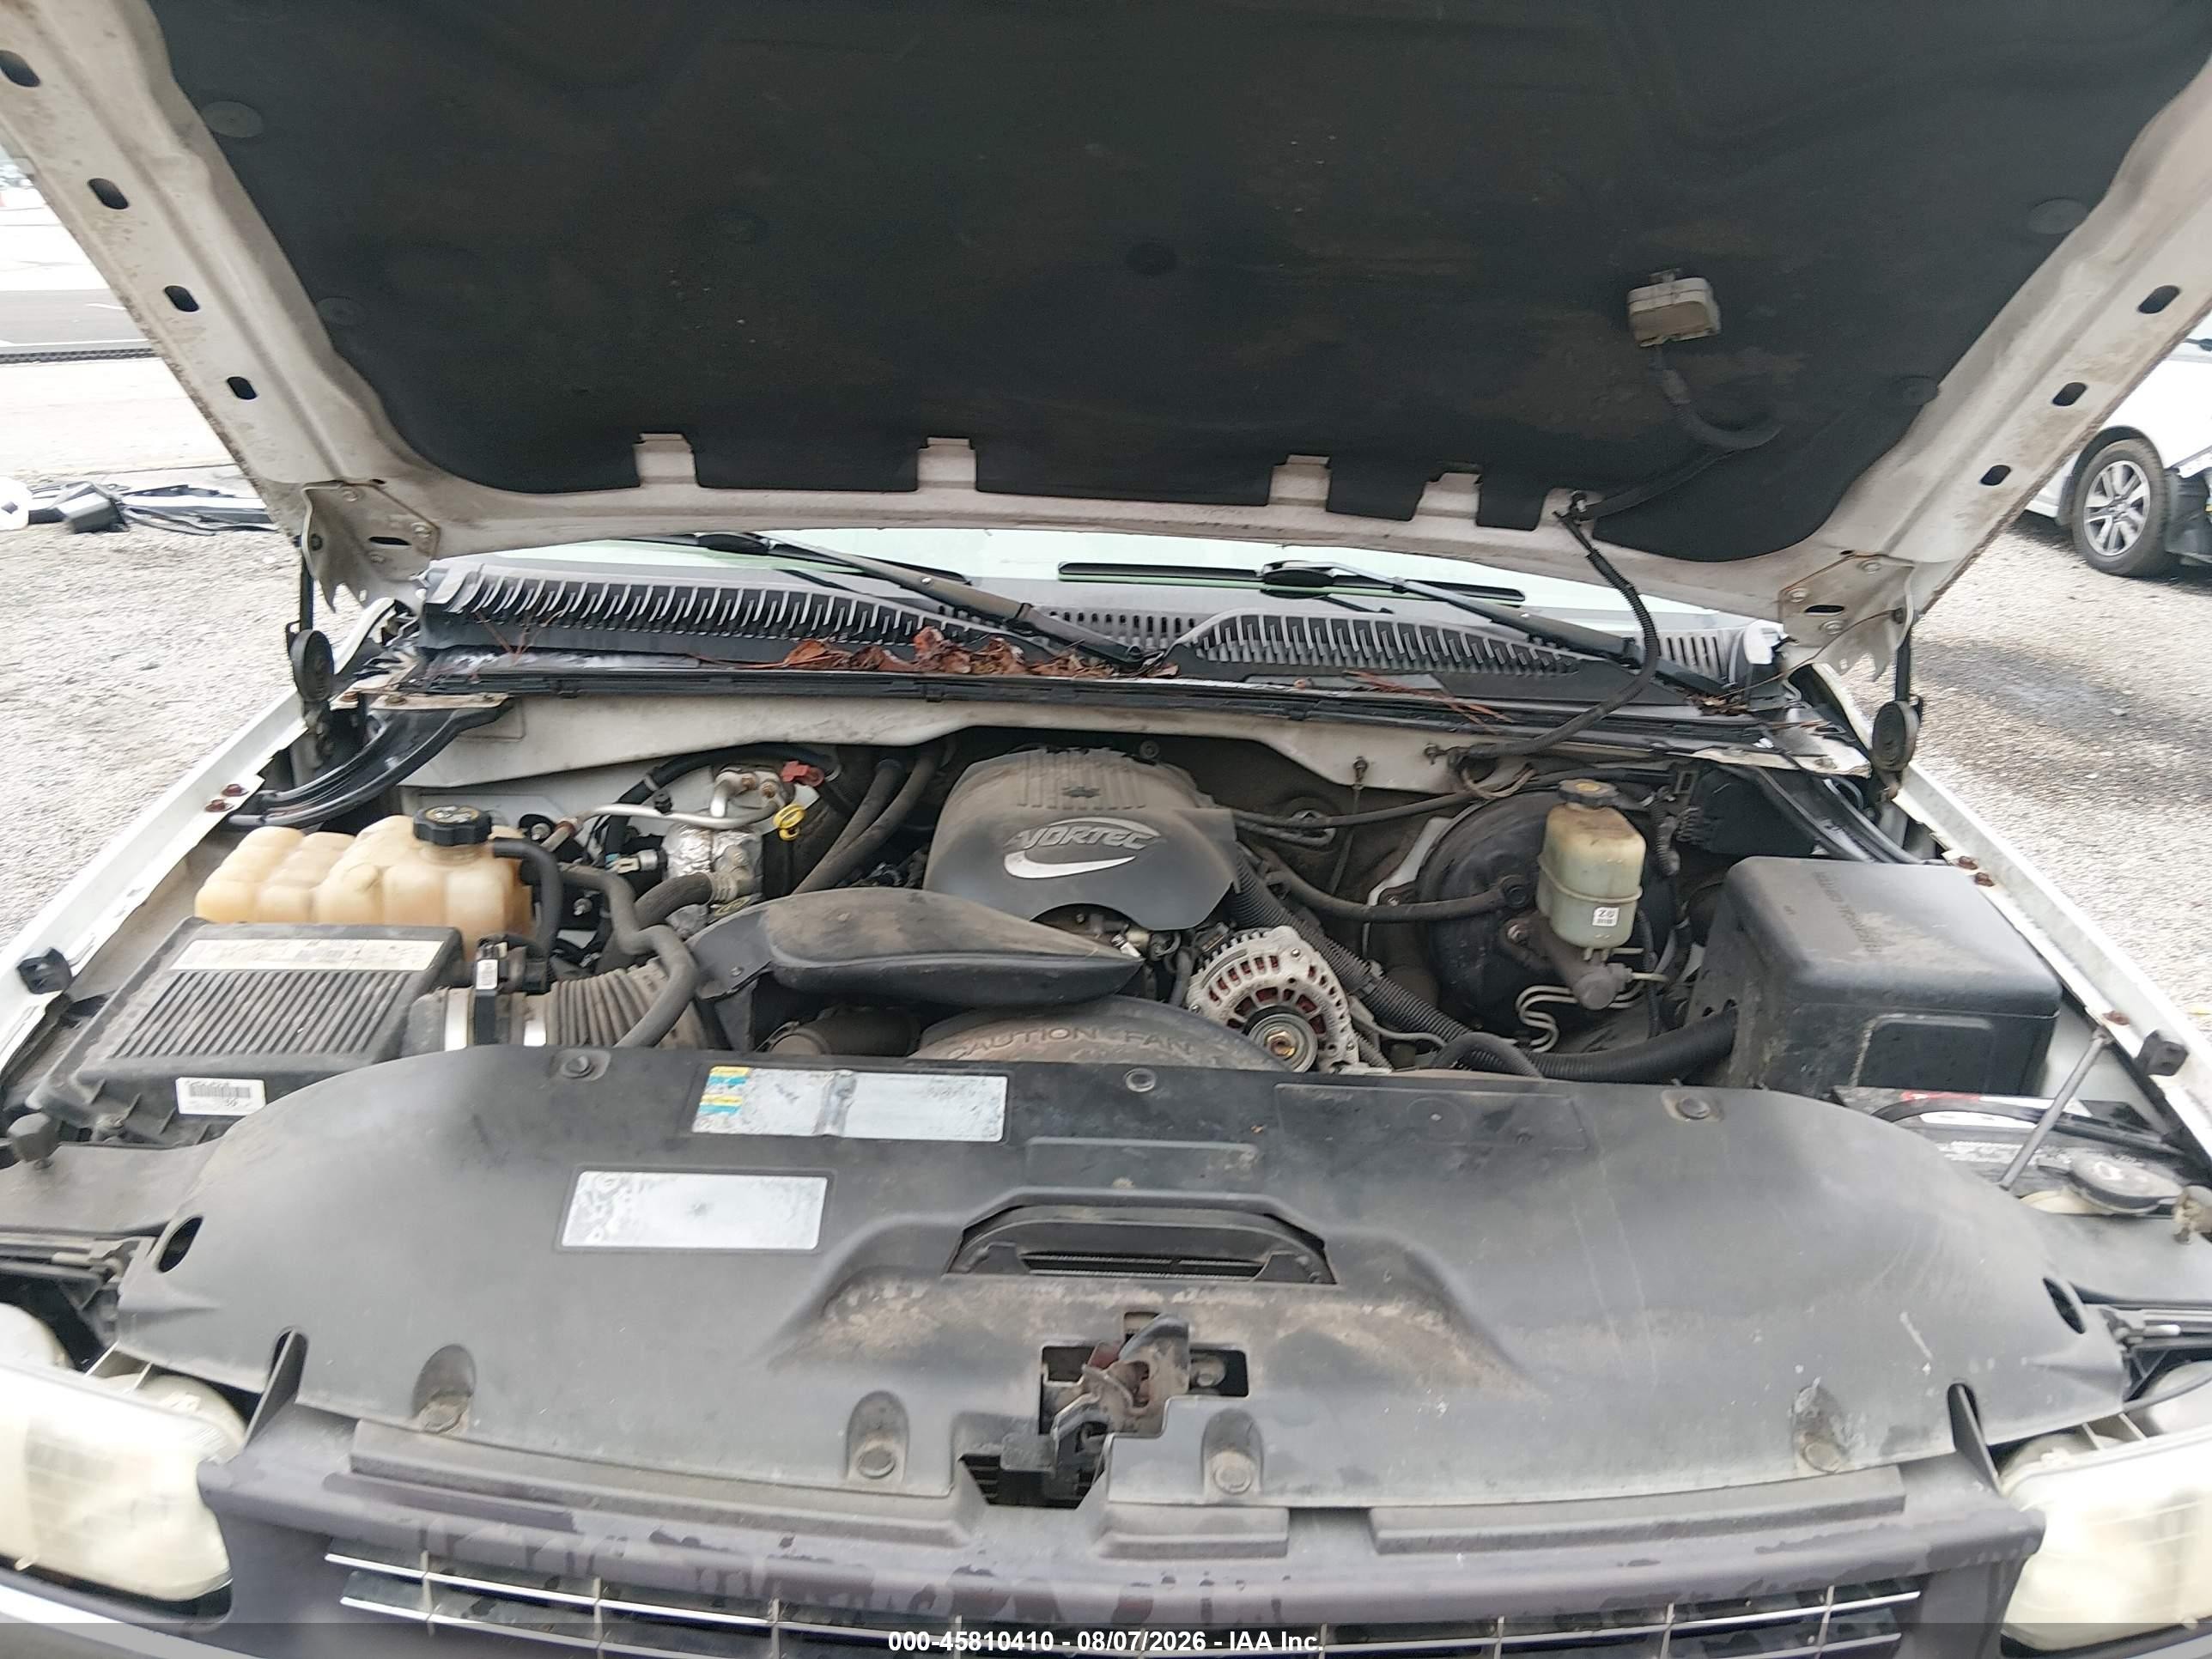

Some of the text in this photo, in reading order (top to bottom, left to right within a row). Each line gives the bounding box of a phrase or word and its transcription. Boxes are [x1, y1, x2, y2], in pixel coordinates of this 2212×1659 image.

[1005, 825, 1154, 850] VORTEC
[948, 1027, 1192, 1060] CAUTION FAN
